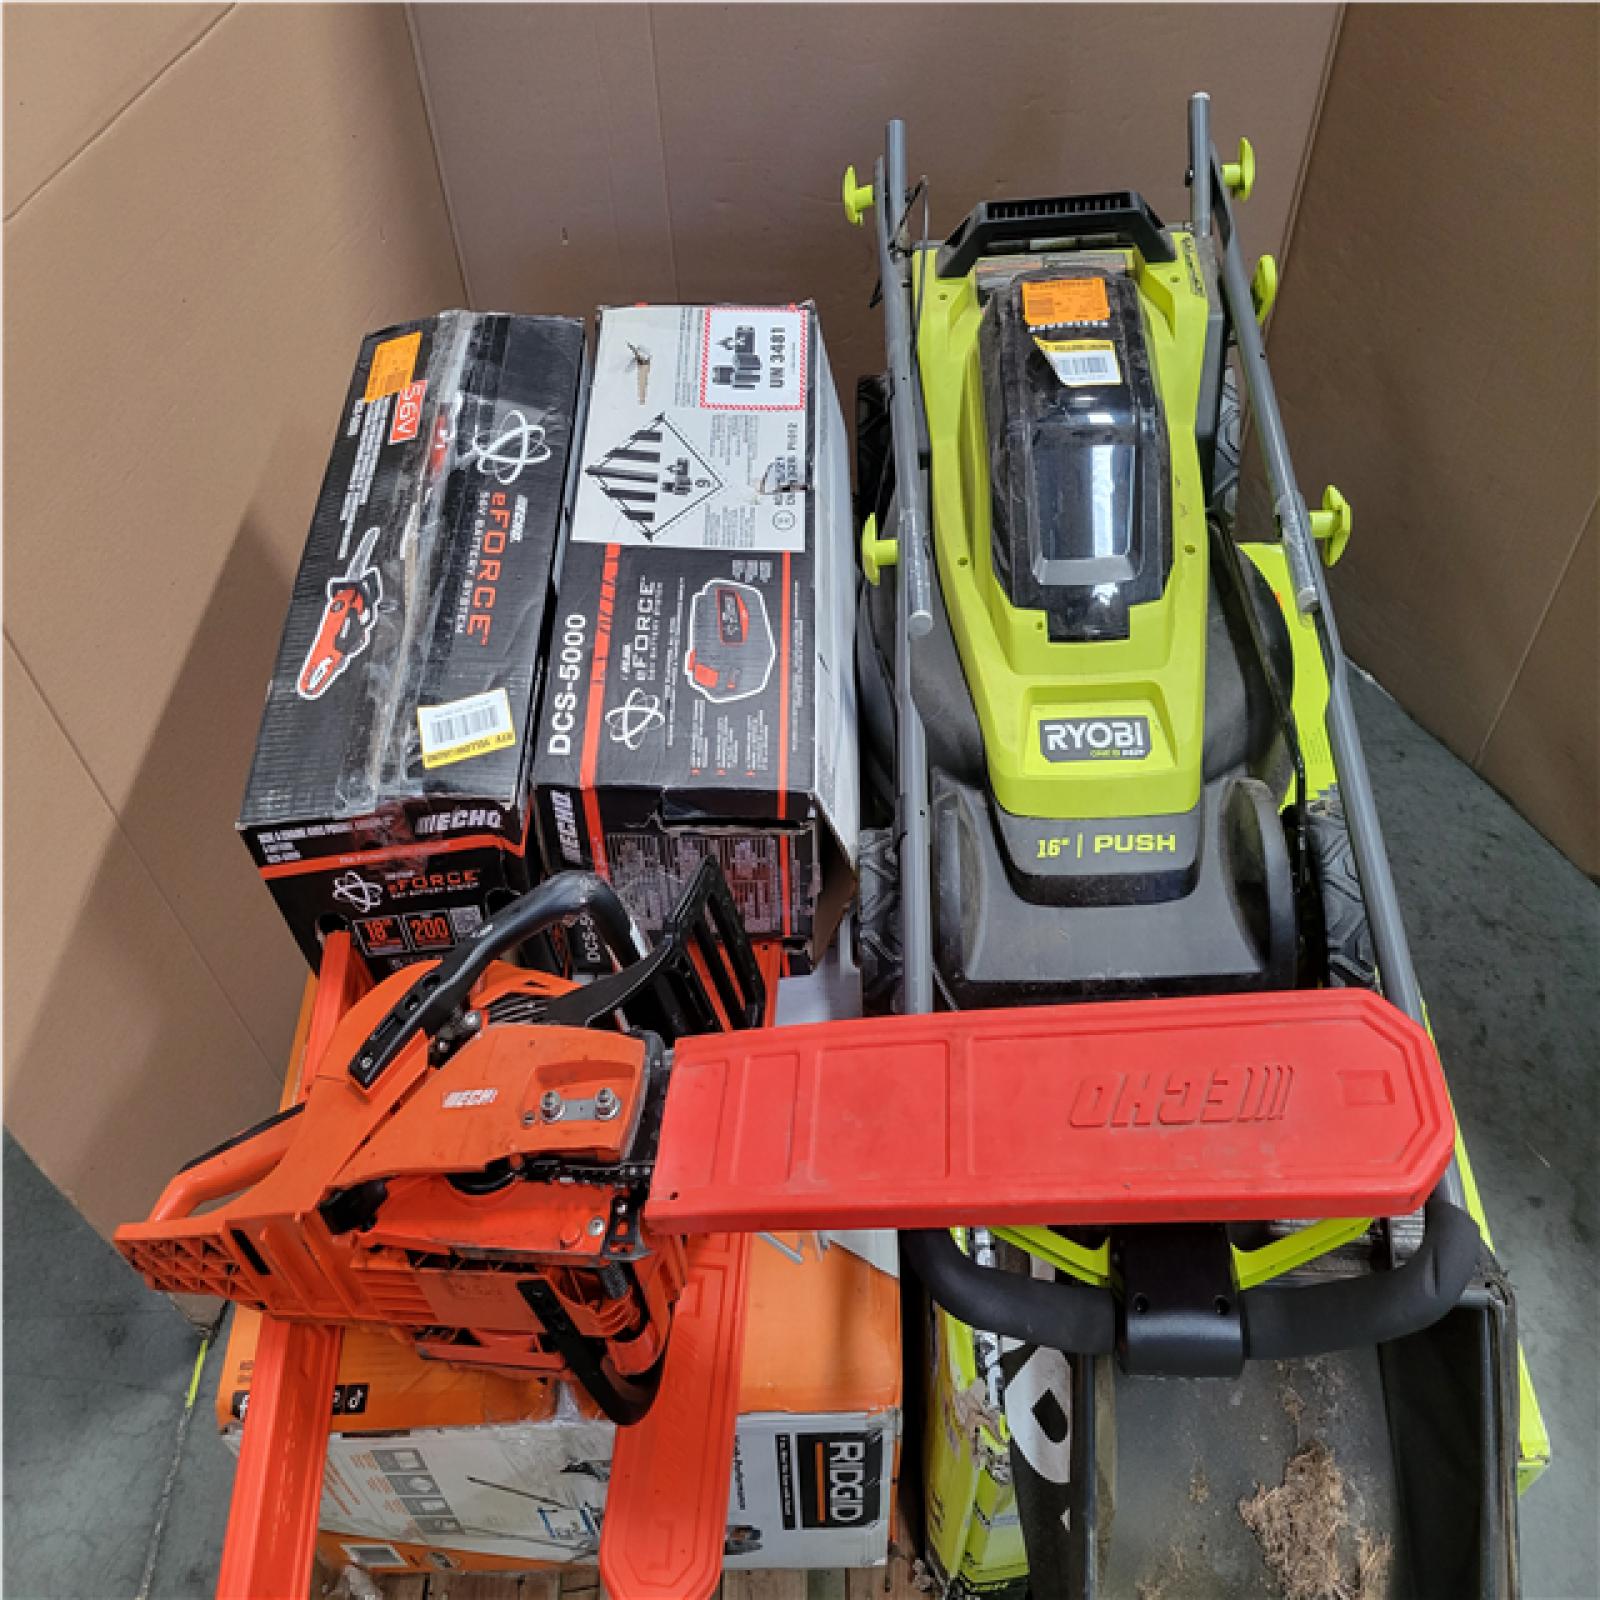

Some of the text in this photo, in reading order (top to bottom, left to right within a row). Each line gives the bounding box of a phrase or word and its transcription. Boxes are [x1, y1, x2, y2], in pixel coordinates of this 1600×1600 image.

[770, 327, 785, 388] UN 3481
[396, 383, 424, 436] 56V
[548, 614, 586, 755] DCS-5000
[1044, 722, 1144, 751] RYOBI
[436, 809, 502, 832] ECHO
[1095, 833, 1176, 854] PUSH
[829, 1441, 865, 1521] RIDGID
